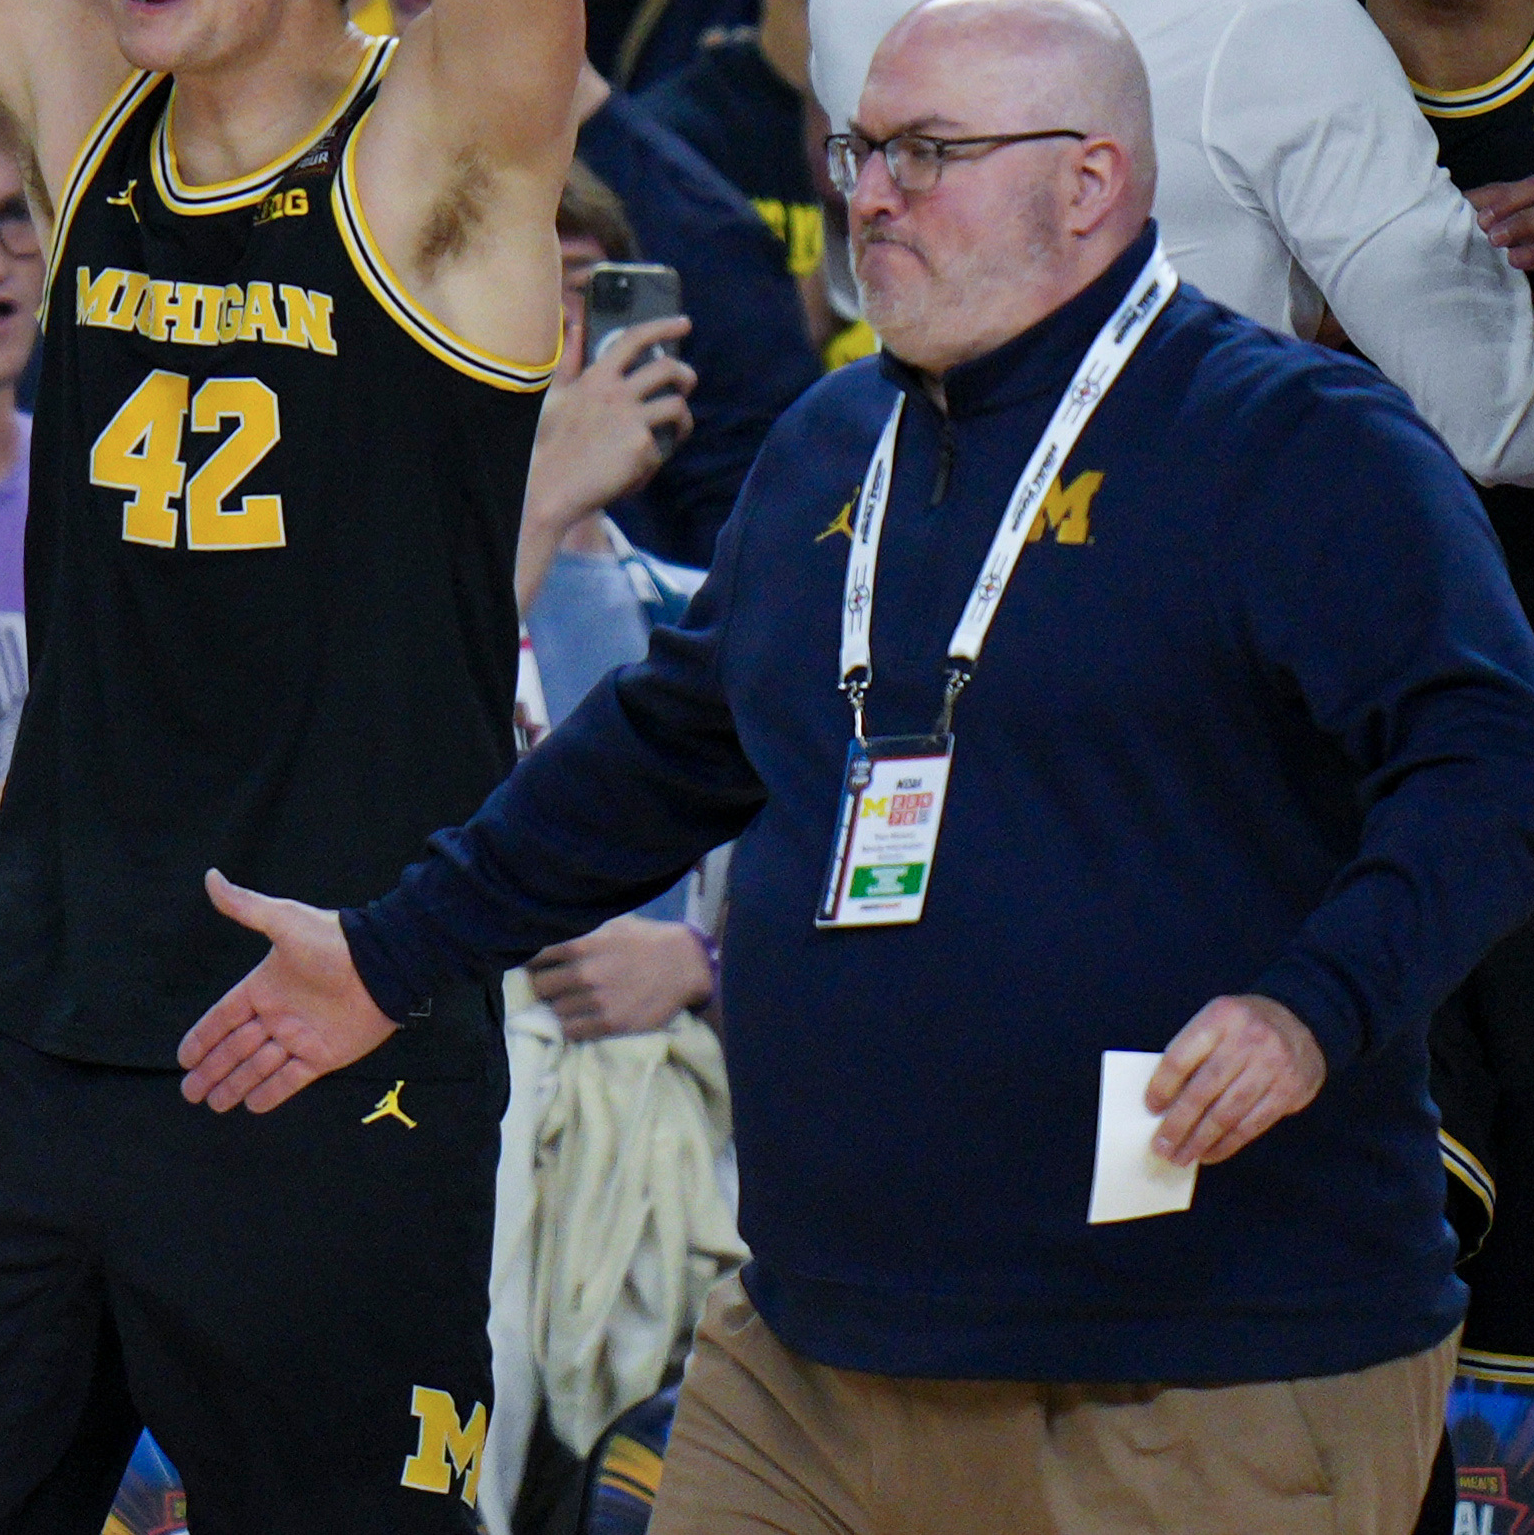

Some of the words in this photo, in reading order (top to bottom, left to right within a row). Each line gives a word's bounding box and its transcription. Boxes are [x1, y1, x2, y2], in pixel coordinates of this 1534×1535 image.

[88, 367, 287, 551] 42
[1023, 469, 1105, 545] M
[861, 796, 889, 818] M
[400, 1384, 487, 1510] M
